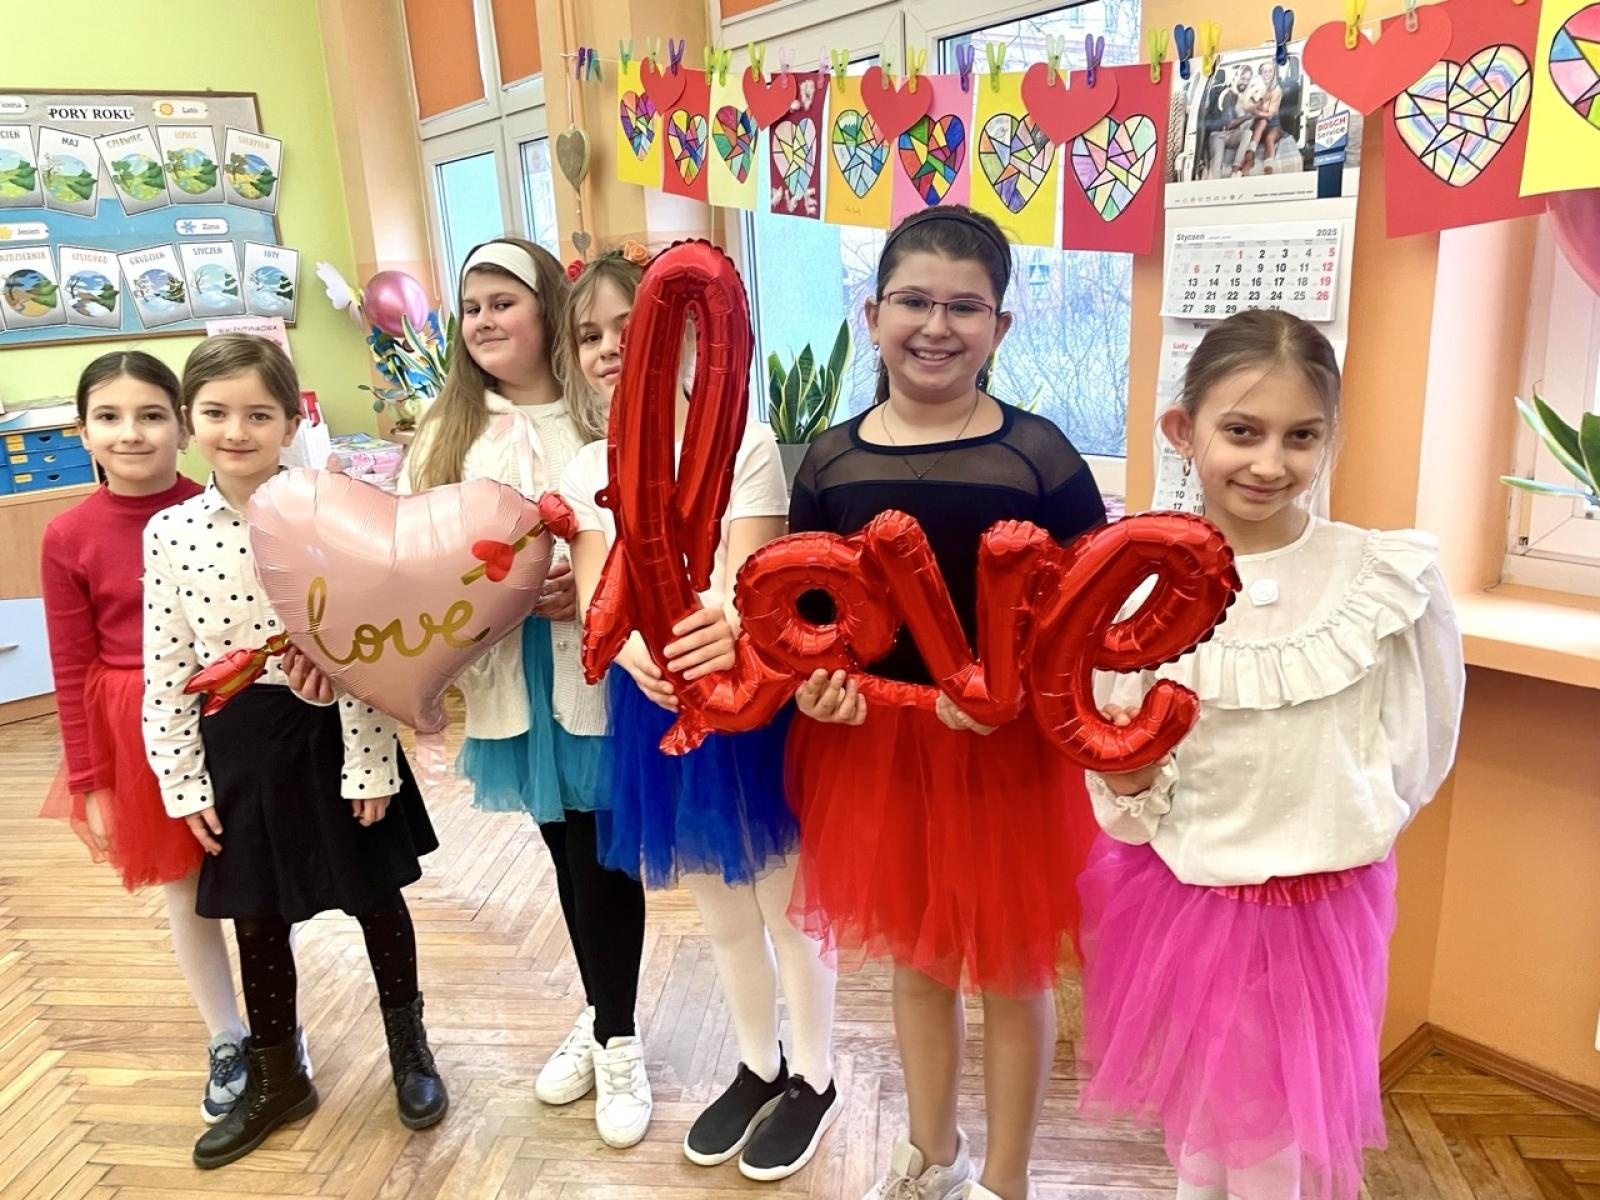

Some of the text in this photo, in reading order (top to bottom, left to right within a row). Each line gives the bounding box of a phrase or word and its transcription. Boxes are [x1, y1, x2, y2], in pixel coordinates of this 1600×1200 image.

[50, 108, 133, 120] PORY ROKU
[182, 106, 199, 114] Lato
[1318, 116, 1346, 132] BOSCH
[61, 137, 79, 148] MAJ
[202, 223, 220, 231] Zima
[1316, 228, 1338, 237] 2025
[72, 252, 108, 264] LISTOPAD
[264, 250, 280, 259] LUTY
[1259, 249, 1266, 259] 2
[1282, 248, 1288, 258] 3
[1305, 248, 1312, 257] 4
[1328, 247, 1336, 257] 5
[1194, 262, 1334, 274] 6 7 8 9 10 11 12
[1188, 276, 1332, 287] 13 14 15 16 17 18 19
[1184, 290, 1330, 301] 20 21 22 23 24 25 26
[1182, 304, 1194, 313] 27
[1204, 304, 1216, 313] 28
[1225, 304, 1237, 314] 29
[1173, 342, 1189, 351] Luty
[1181, 478, 1187, 487] 3
[1175, 490, 1185, 499] 10
[1173, 502, 1183, 511] 17
[308, 577, 491, 665] love
